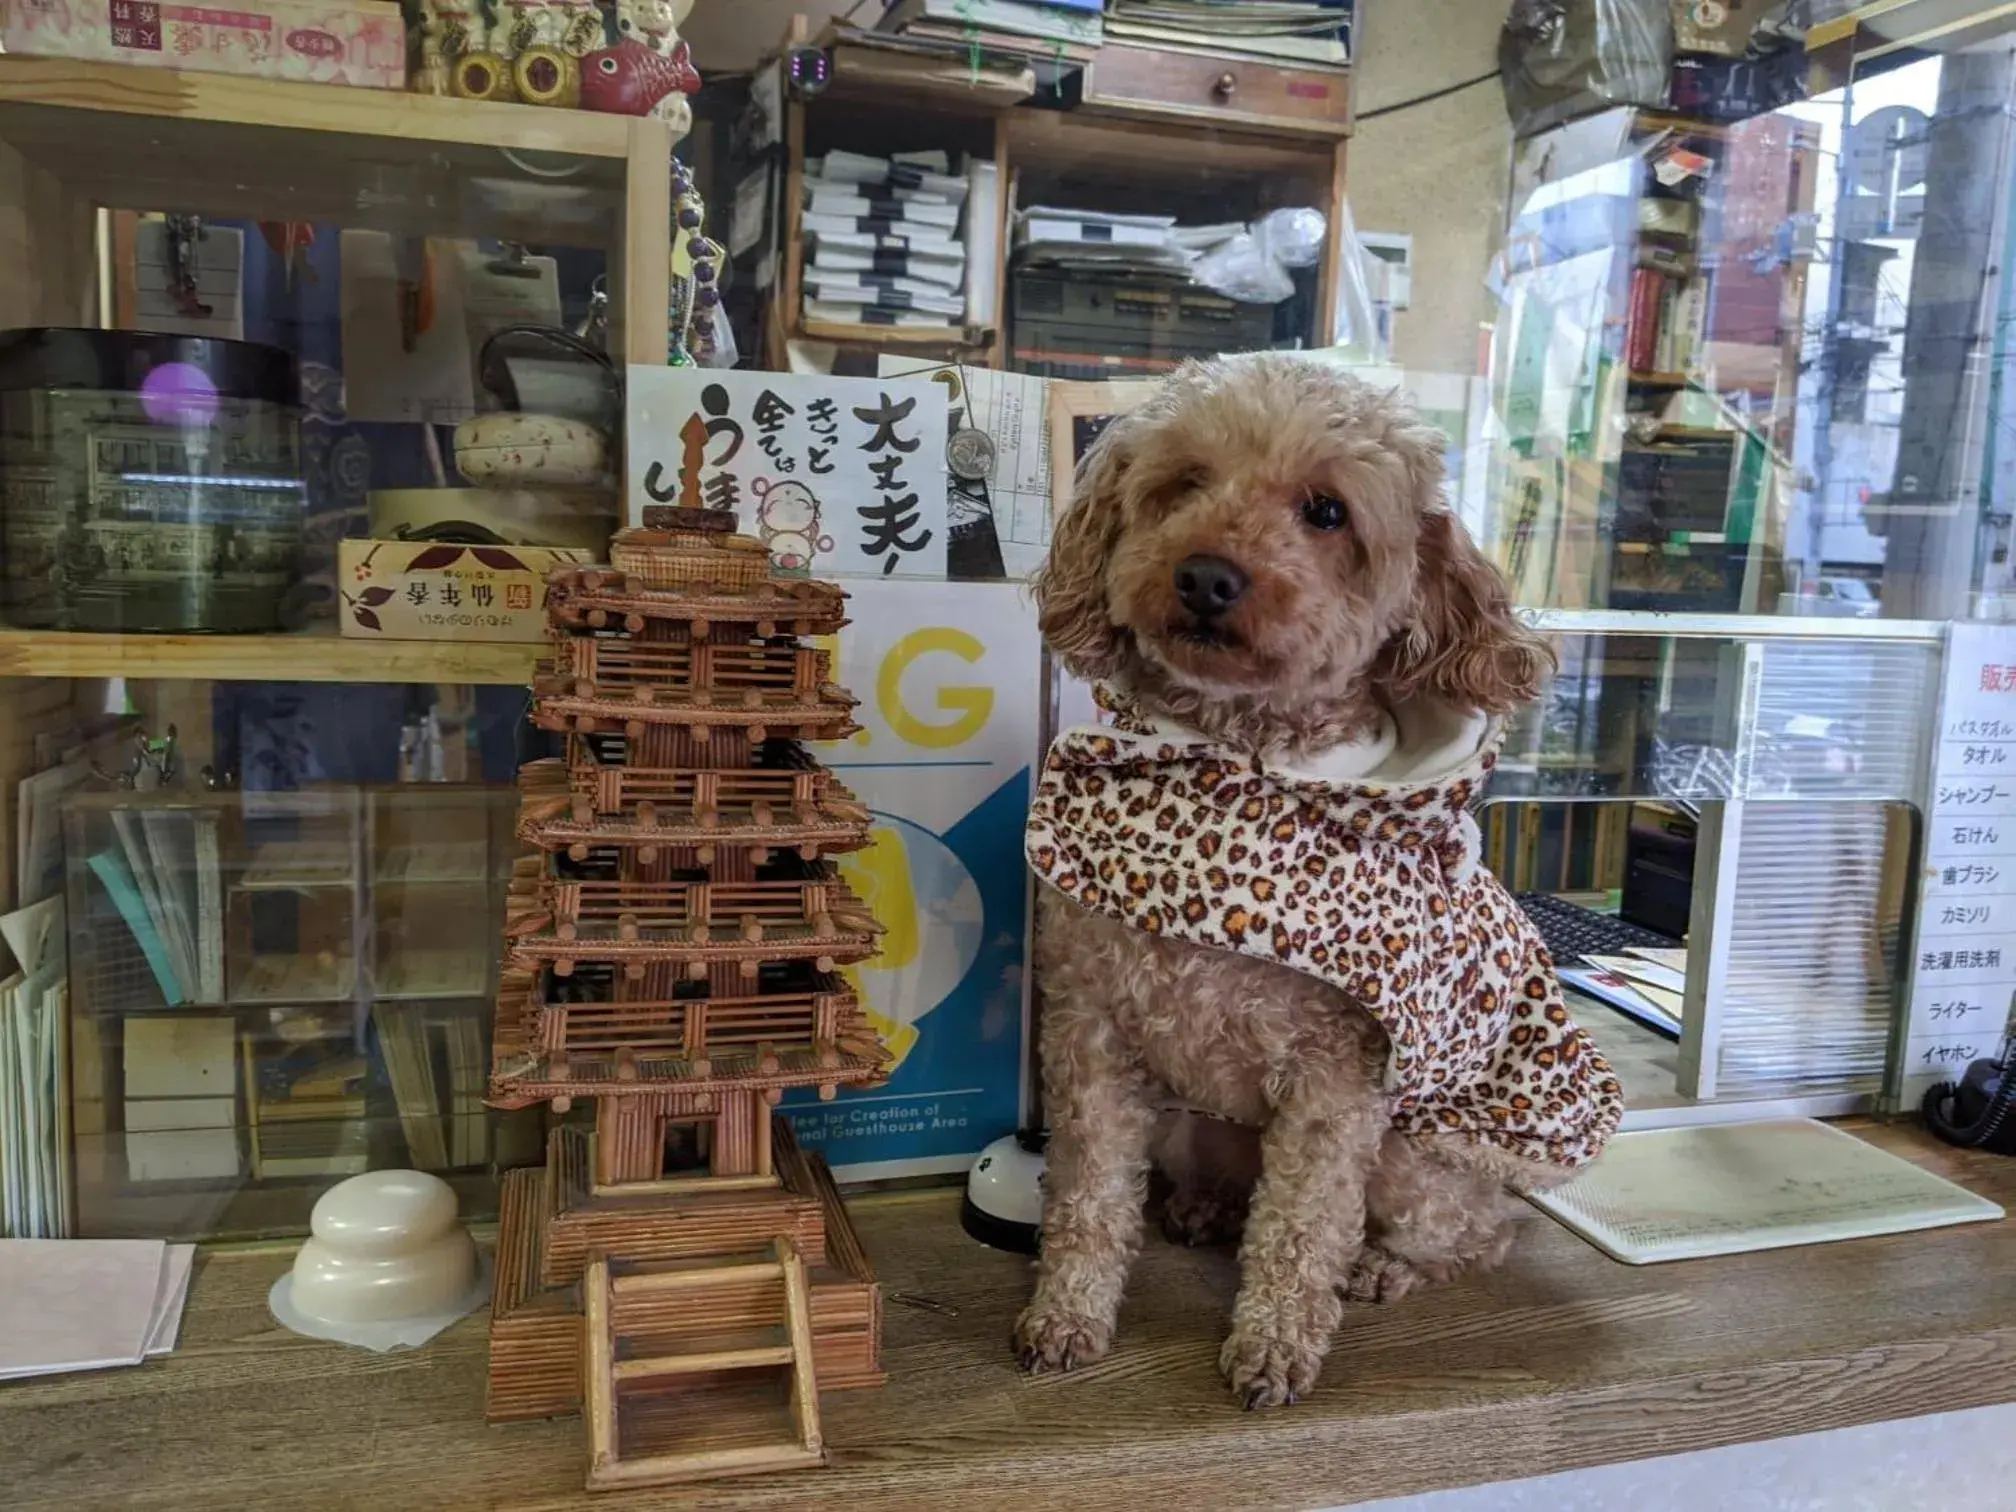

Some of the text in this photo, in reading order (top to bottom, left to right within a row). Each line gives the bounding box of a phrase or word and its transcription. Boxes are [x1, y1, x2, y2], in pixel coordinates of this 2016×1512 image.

[752, 389, 796, 473] 全ては
[806, 398, 838, 474] きっと
[406, 582, 494, 607] 仙年香
[419, 614, 513, 627] けむりの少ない
[1963, 746, 2007, 764] タオル
[1939, 785, 2010, 804] シャンプー
[1952, 826, 1999, 845] 石けん
[1942, 865, 1999, 885] 歯ブラシ
[1941, 906, 1990, 924] カミソリ
[1920, 949, 2001, 971] 洗濯用洗剤
[1929, 1002, 1983, 1020] ライター
[1922, 1045, 1979, 1064] イヤホン
[824, 1112, 845, 1125] for
[850, 1104, 919, 1123] Creation
[924, 1103, 940, 1117] of
[832, 1120, 925, 1139] Guesthouse
[931, 1116, 968, 1130] Area
